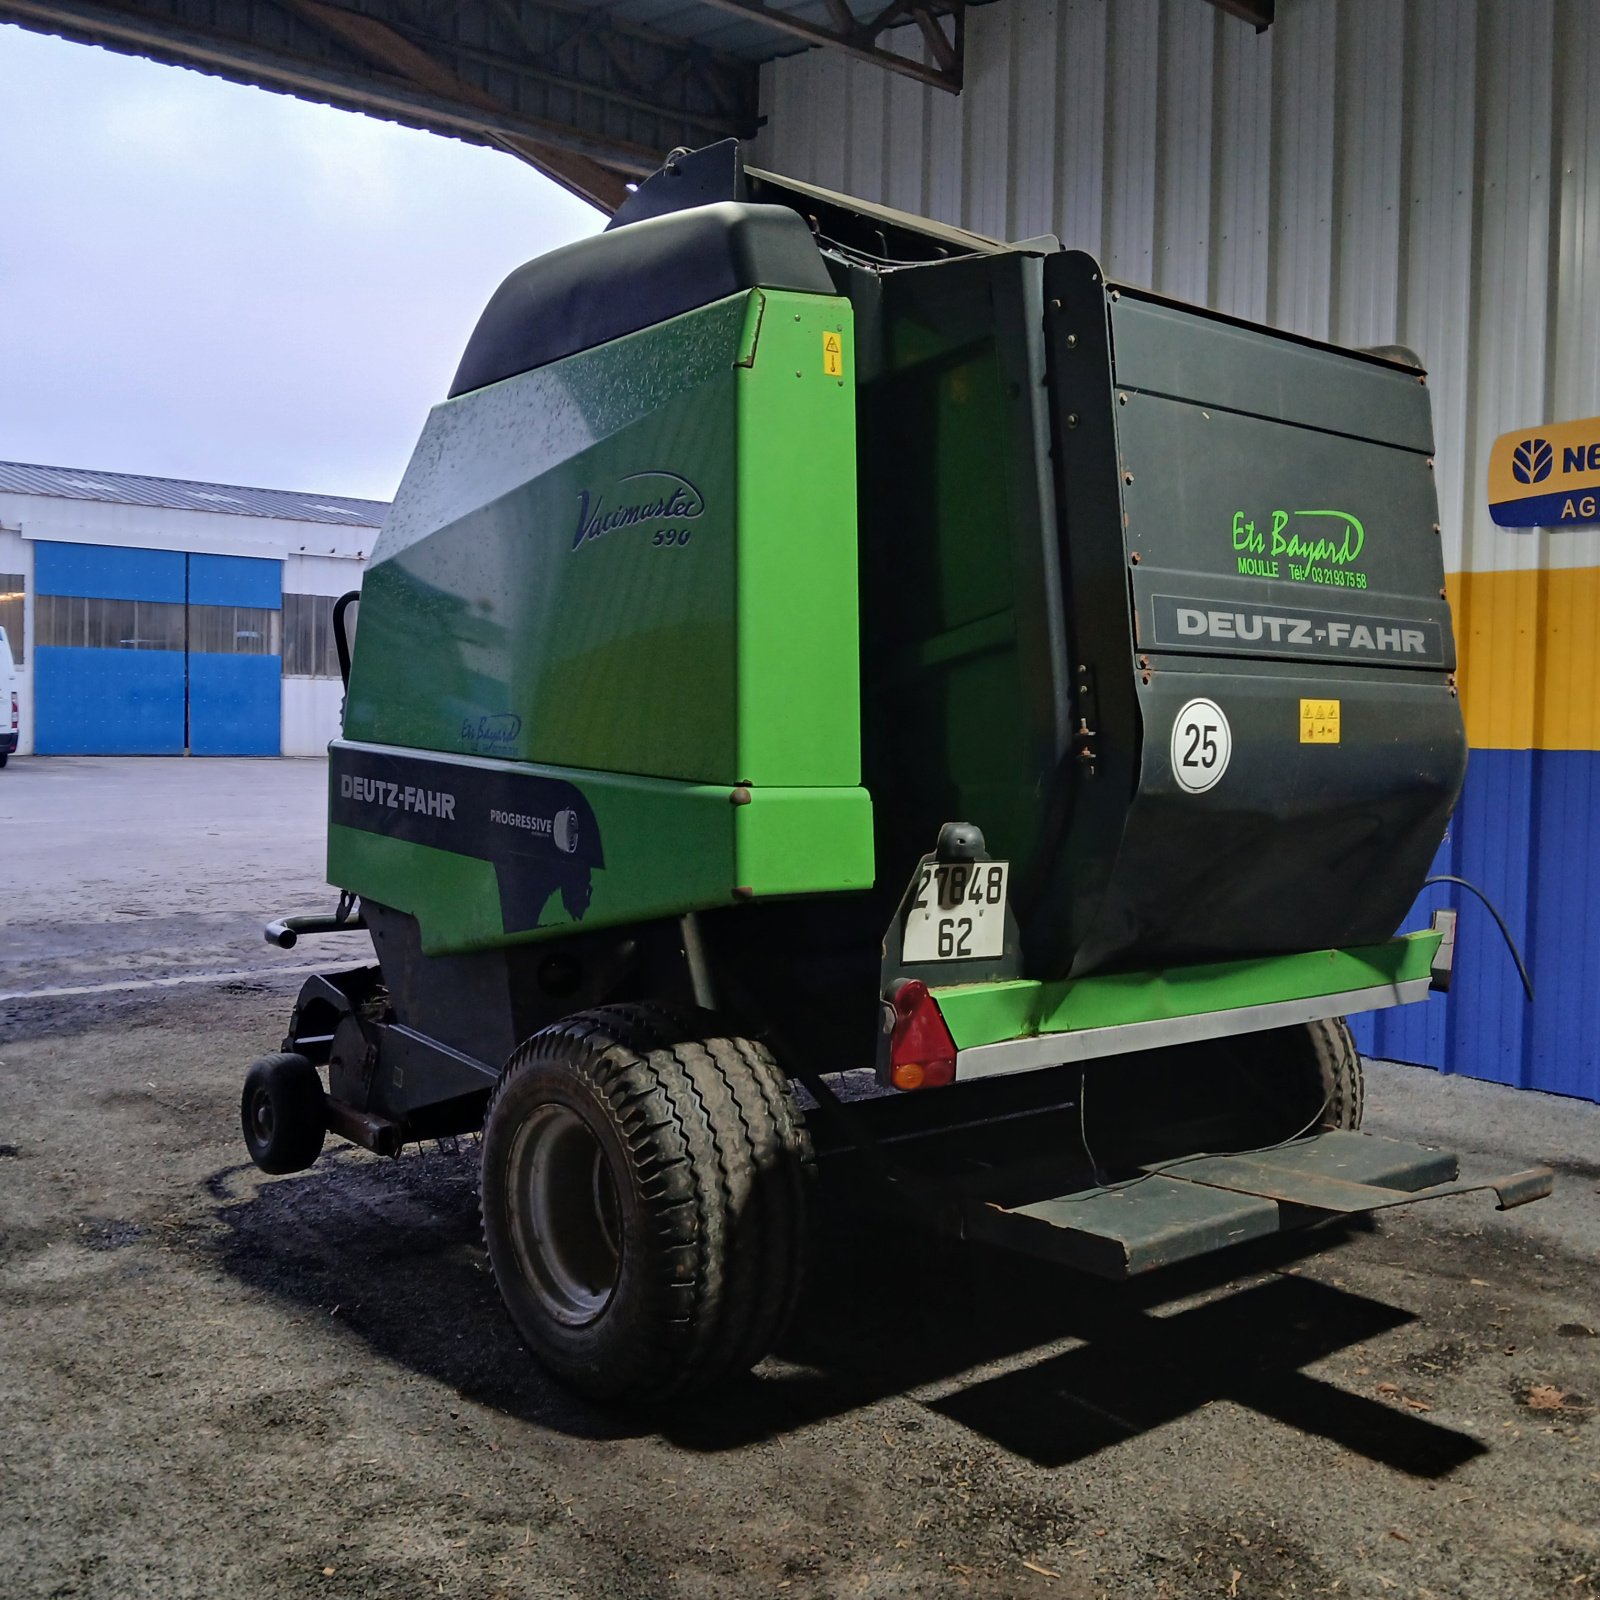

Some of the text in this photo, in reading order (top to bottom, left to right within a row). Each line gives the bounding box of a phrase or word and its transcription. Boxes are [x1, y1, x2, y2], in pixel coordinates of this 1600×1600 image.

[652, 528, 692, 547] 590
[1271, 509, 1365, 577] Bayard
[1237, 557, 1280, 578] MOULLE
[1176, 608, 1427, 654] DEUTZ-FAHR
[1182, 723, 1217, 768] 25
[340, 773, 456, 821] DEUTZ-FAHR
[489, 808, 552, 833] PROGRESSIVE
[912, 866, 1003, 909] 27848
[937, 917, 973, 957] 62
